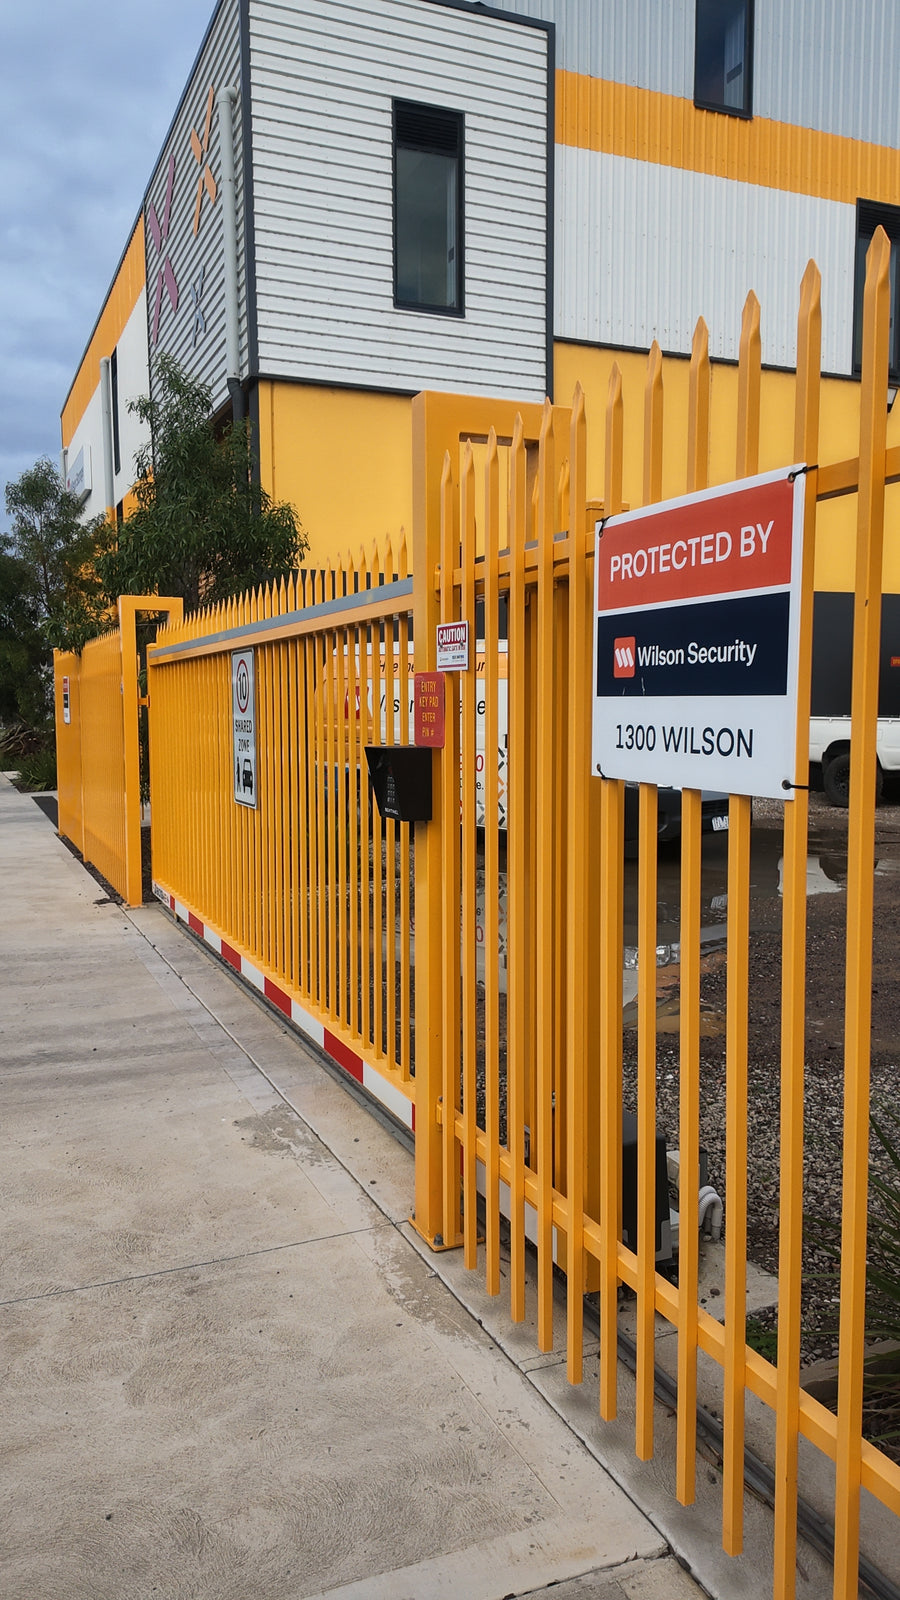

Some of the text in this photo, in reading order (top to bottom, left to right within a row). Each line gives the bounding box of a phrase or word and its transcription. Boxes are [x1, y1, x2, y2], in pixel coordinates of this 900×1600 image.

[610, 520, 775, 582] PROTECTED BY
[439, 626, 465, 645] CAUTION
[638, 639, 757, 667] Wilson Security
[239, 672, 247, 700] 10
[421, 681, 437, 693] ENTRY
[419, 696, 428, 708] KEY
[429, 696, 439, 708] PAD
[422, 712, 436, 723] ENTER
[235, 720, 252, 733] SHARED
[422, 726, 430, 737] PIN
[238, 739, 250, 752] ZONE
[615, 724, 754, 759] 1300 WILSON
